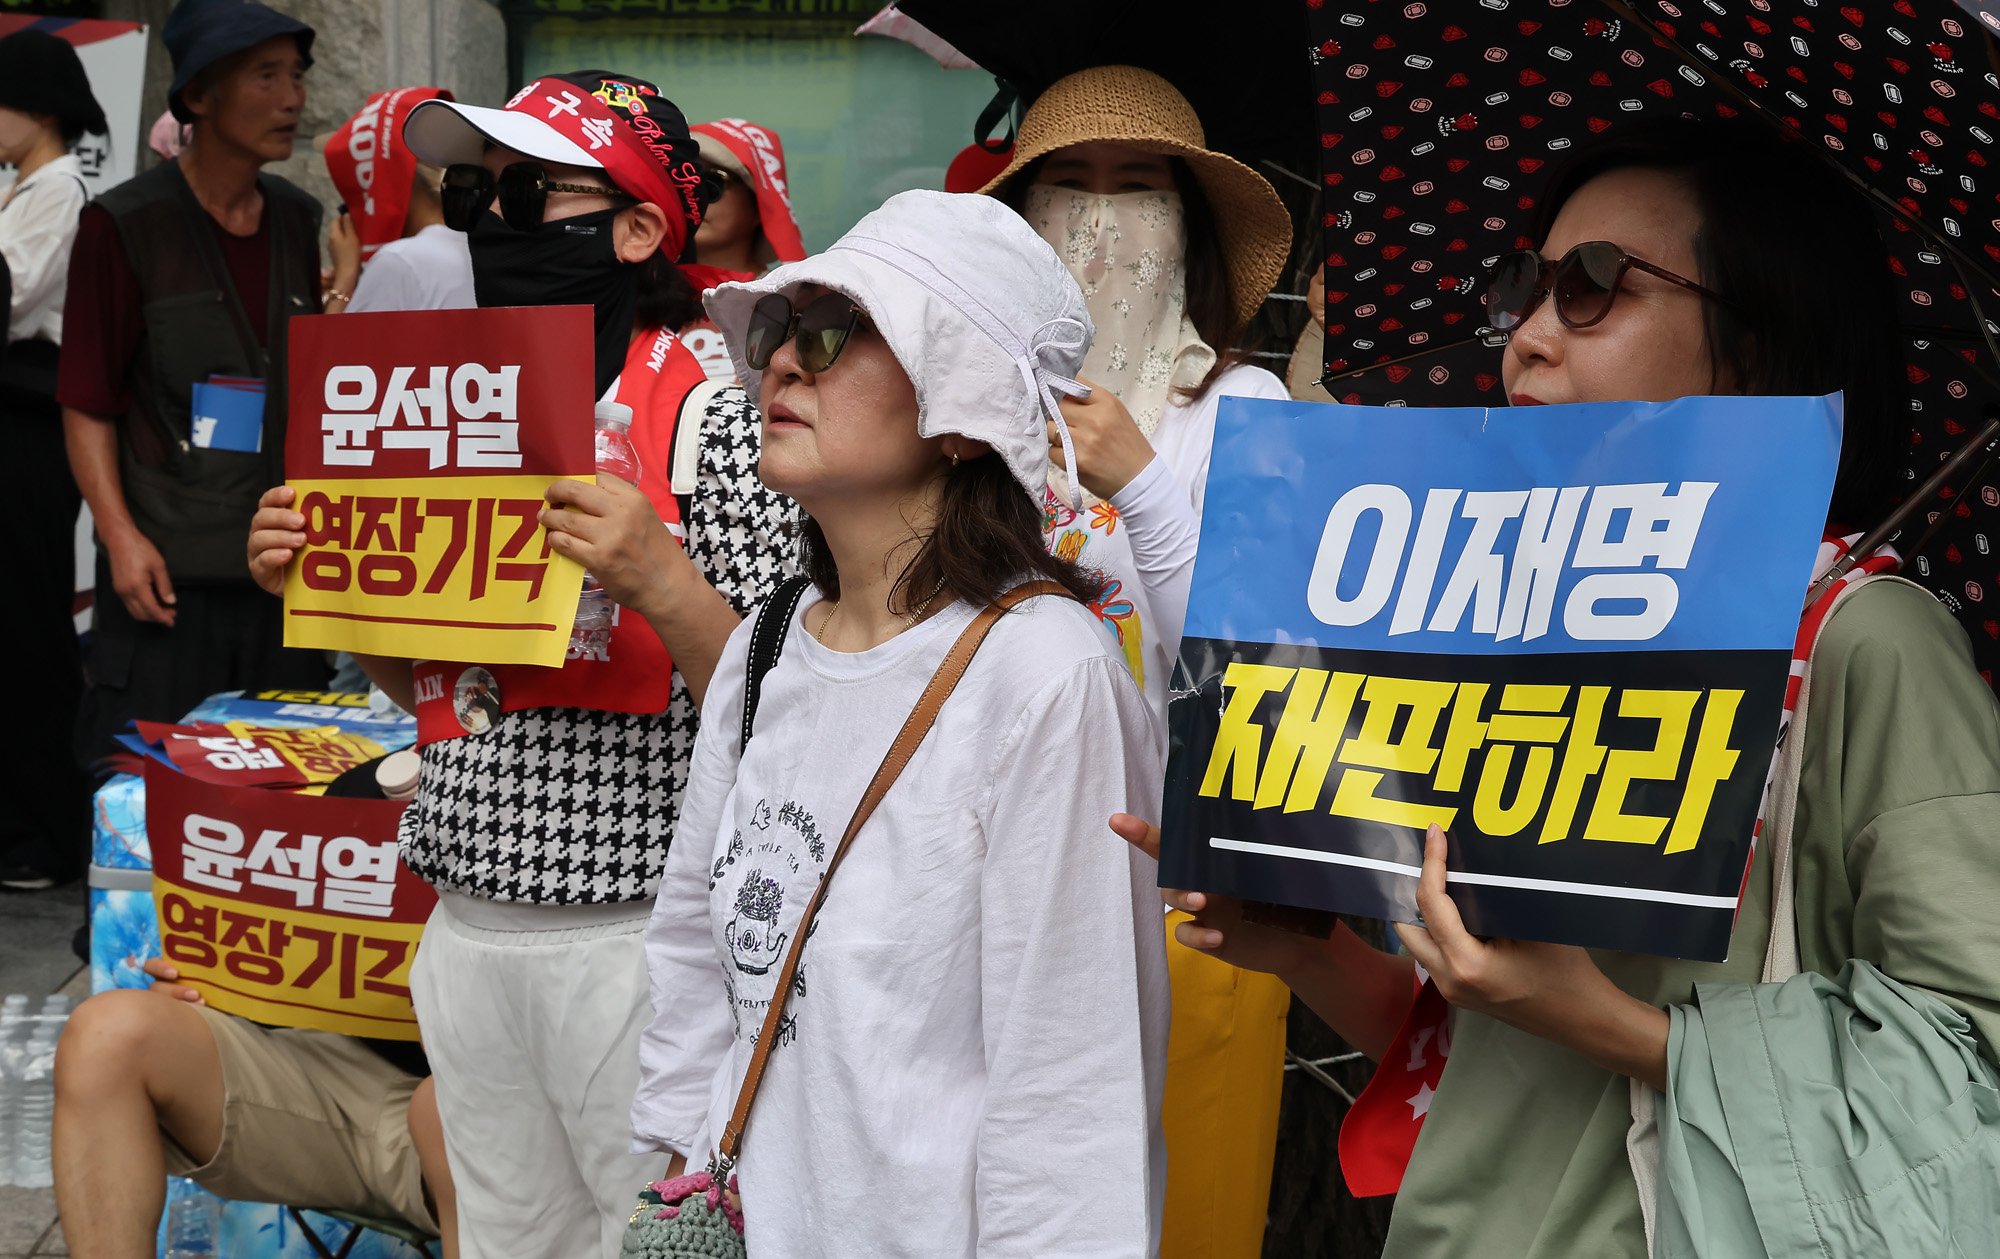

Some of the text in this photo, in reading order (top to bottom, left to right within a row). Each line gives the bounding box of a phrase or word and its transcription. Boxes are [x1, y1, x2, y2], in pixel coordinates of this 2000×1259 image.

[633, 115, 701, 226] Palm Springs
[646, 324, 676, 373] MAK
[321, 362, 523, 470] 윤석열
[300, 491, 560, 603] 영장기각
[1307, 481, 1719, 642] 이재명
[1198, 662, 1745, 855] 재판하라
[182, 813, 400, 918] 윤석열
